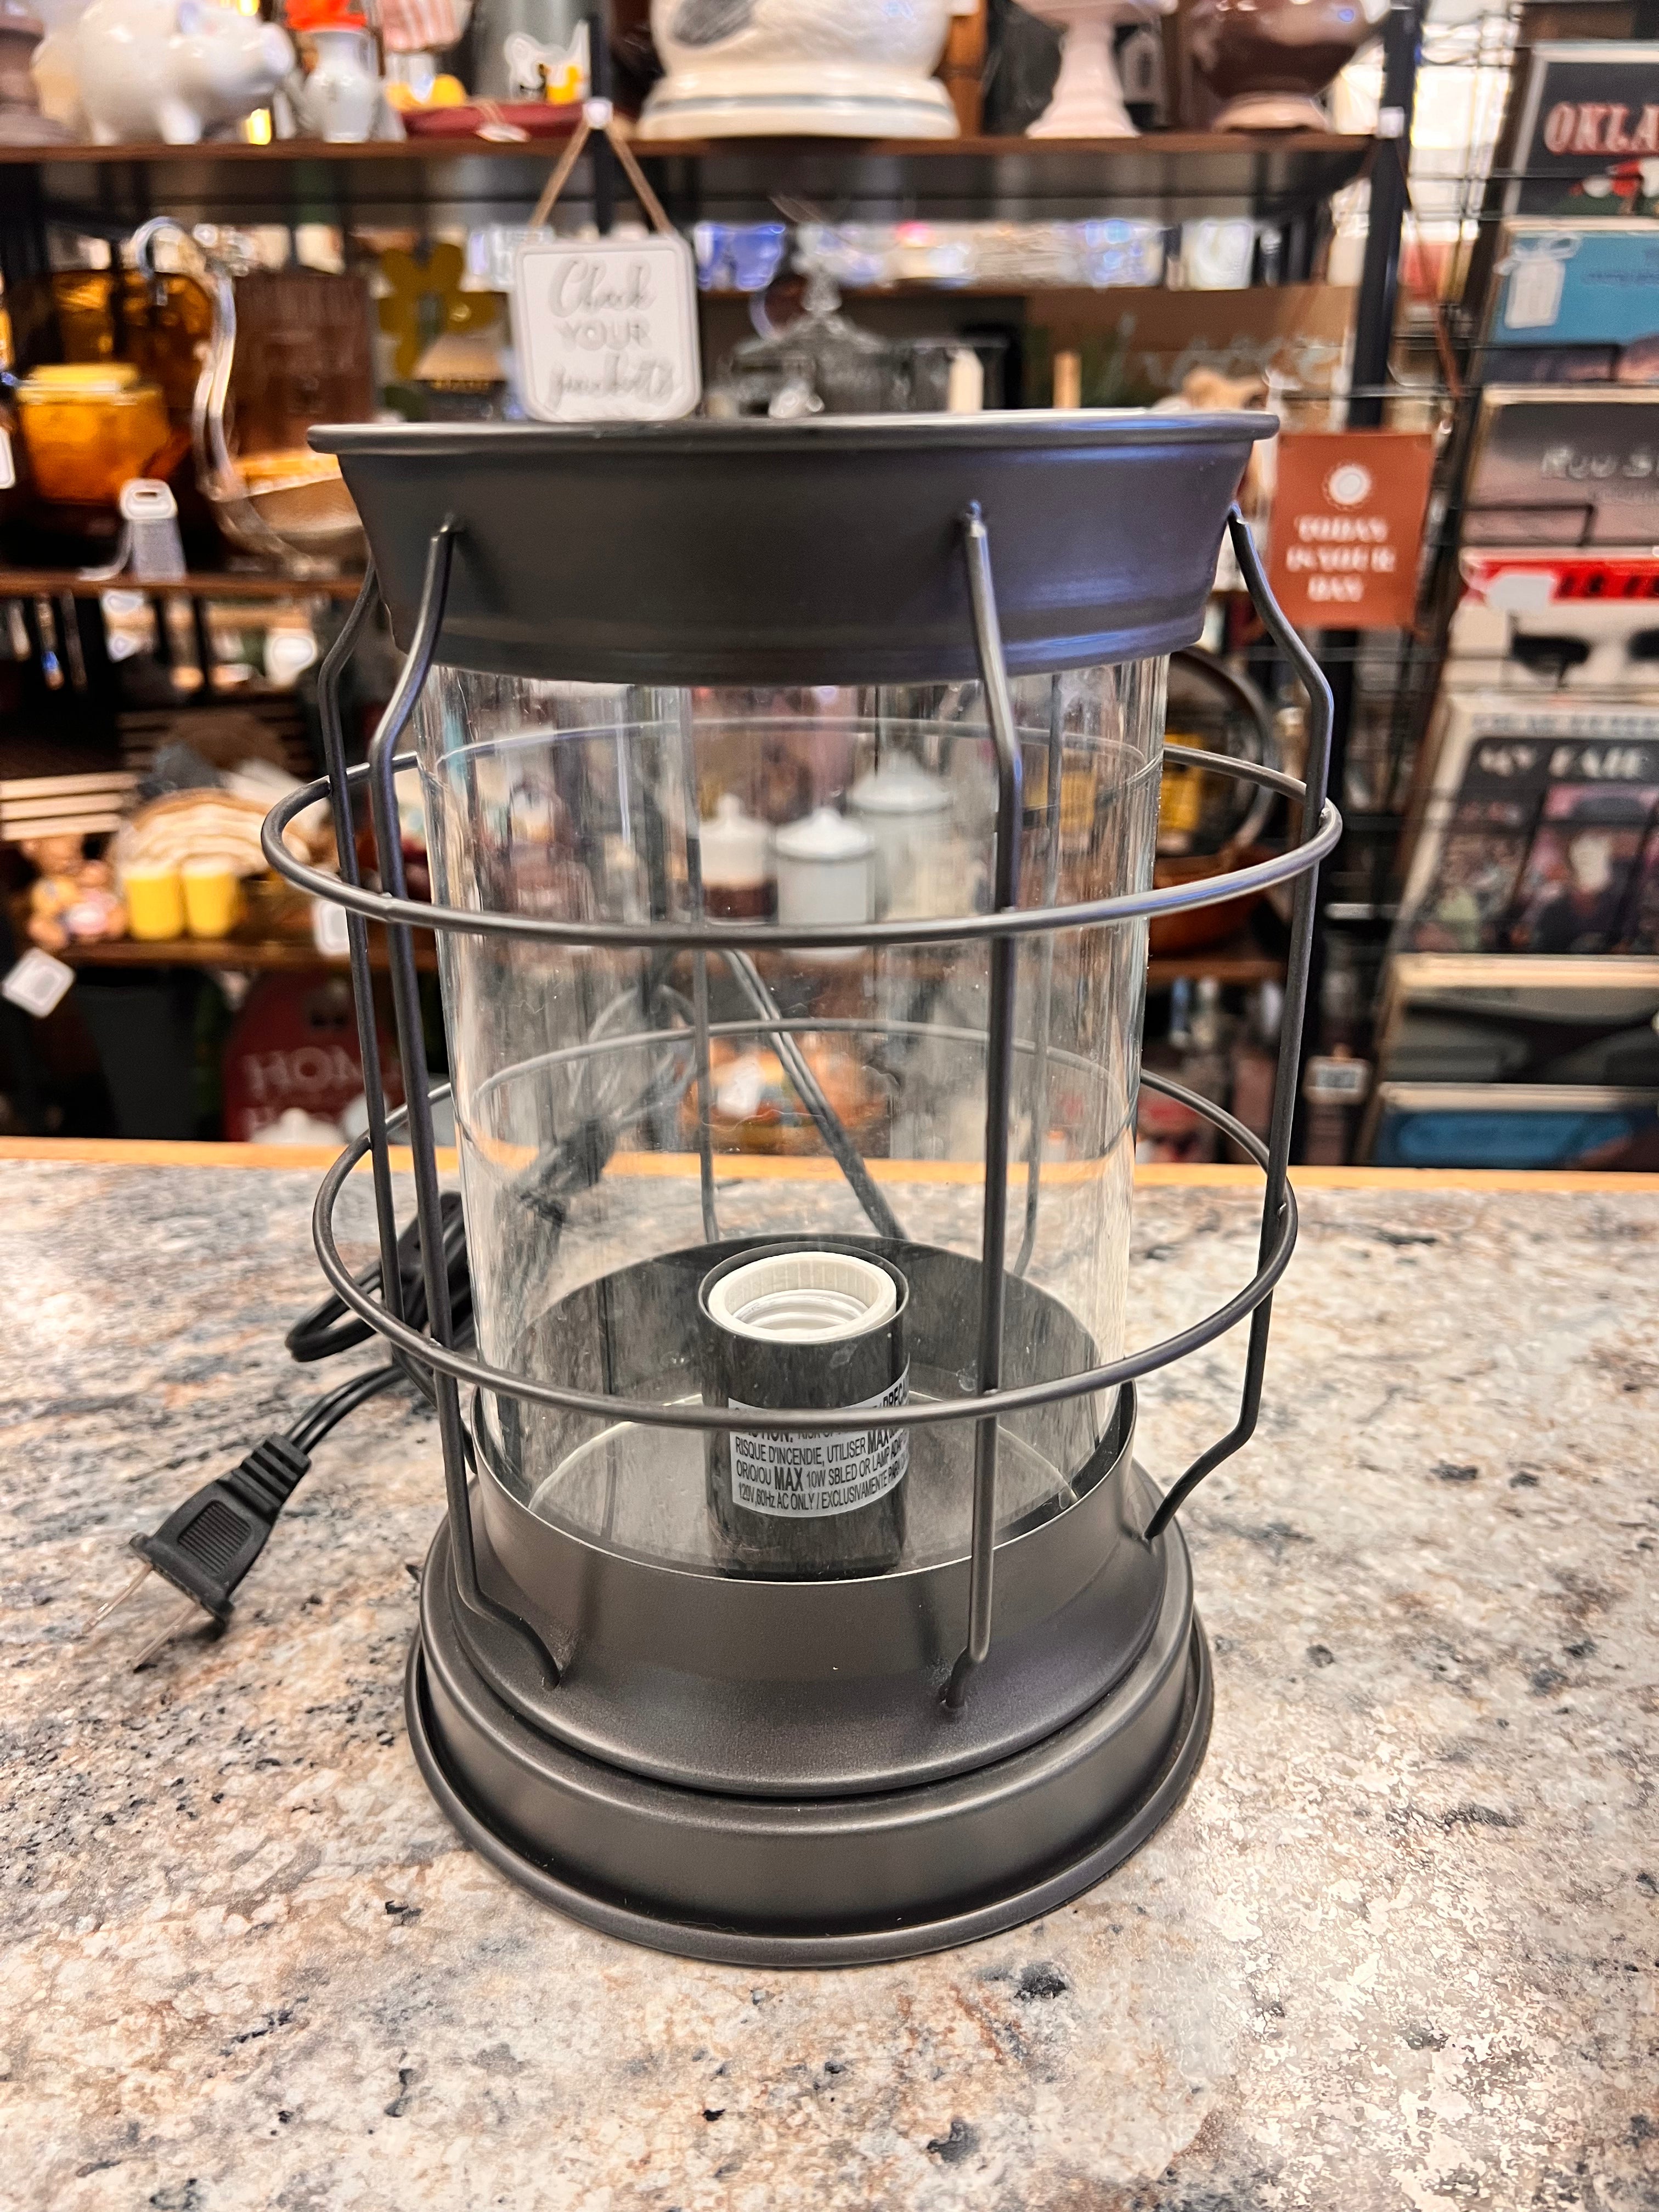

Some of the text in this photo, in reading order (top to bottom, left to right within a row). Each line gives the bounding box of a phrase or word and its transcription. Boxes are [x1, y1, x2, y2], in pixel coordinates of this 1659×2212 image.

[554, 319, 651, 350] YOUR
[735, 1436, 766, 1462] RISQUE
[768, 1446, 825, 1466] D'INCENDIE,
[827, 1437, 866, 1463] UTILISER
[868, 1429, 888, 1454] MAX
[736, 1459, 771, 1486] OR/O/OU
[774, 1465, 804, 1492] MAX
[806, 1469, 826, 1488] 10W
[828, 1463, 857, 1486] SBLED
[859, 1458, 871, 1477] OR
[873, 1446, 890, 1471] LAMP
[777, 1492, 789, 1509] AC
[791, 1493, 815, 1510] ONLY
[822, 1469, 888, 1509] EXCLUSIVAMENTE
